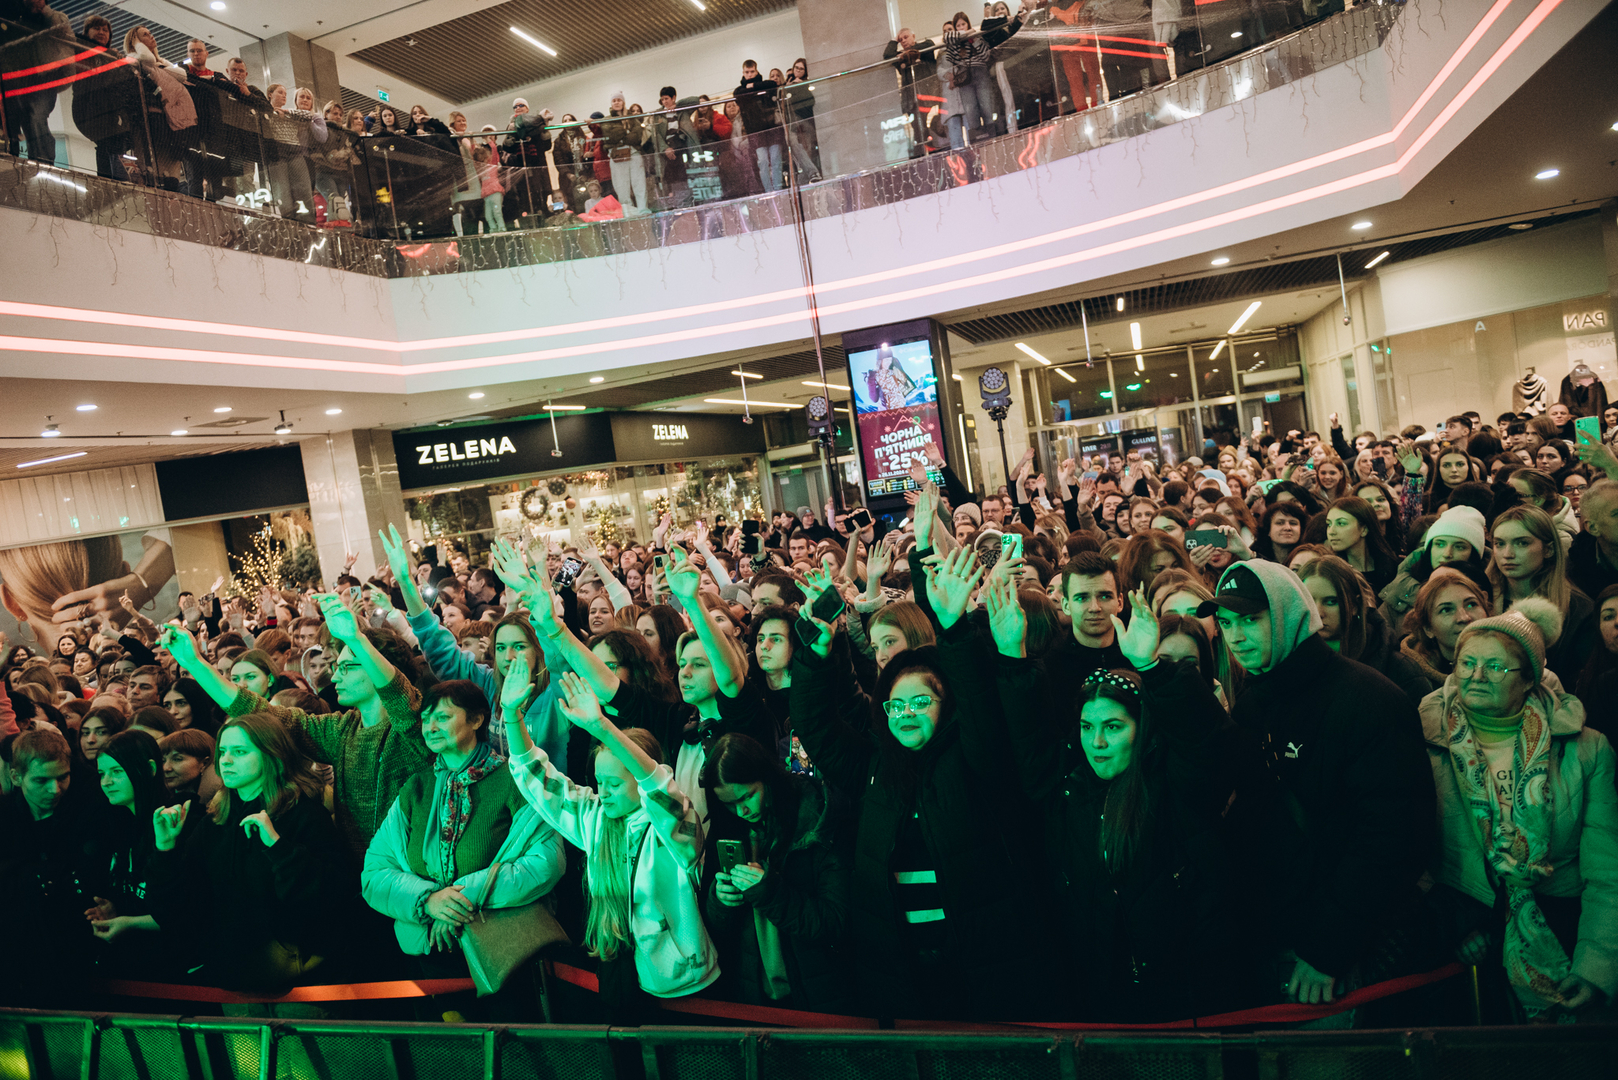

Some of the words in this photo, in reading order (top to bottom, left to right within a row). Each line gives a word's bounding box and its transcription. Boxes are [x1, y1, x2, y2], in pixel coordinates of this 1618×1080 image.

[652, 424, 689, 440] ZELENA
[880, 425, 922, 444] ЧОРНА
[415, 435, 517, 465] ZELENA
[874, 433, 932, 459] П'ЯТНИЦЯ
[882, 450, 928, 470] -25%
